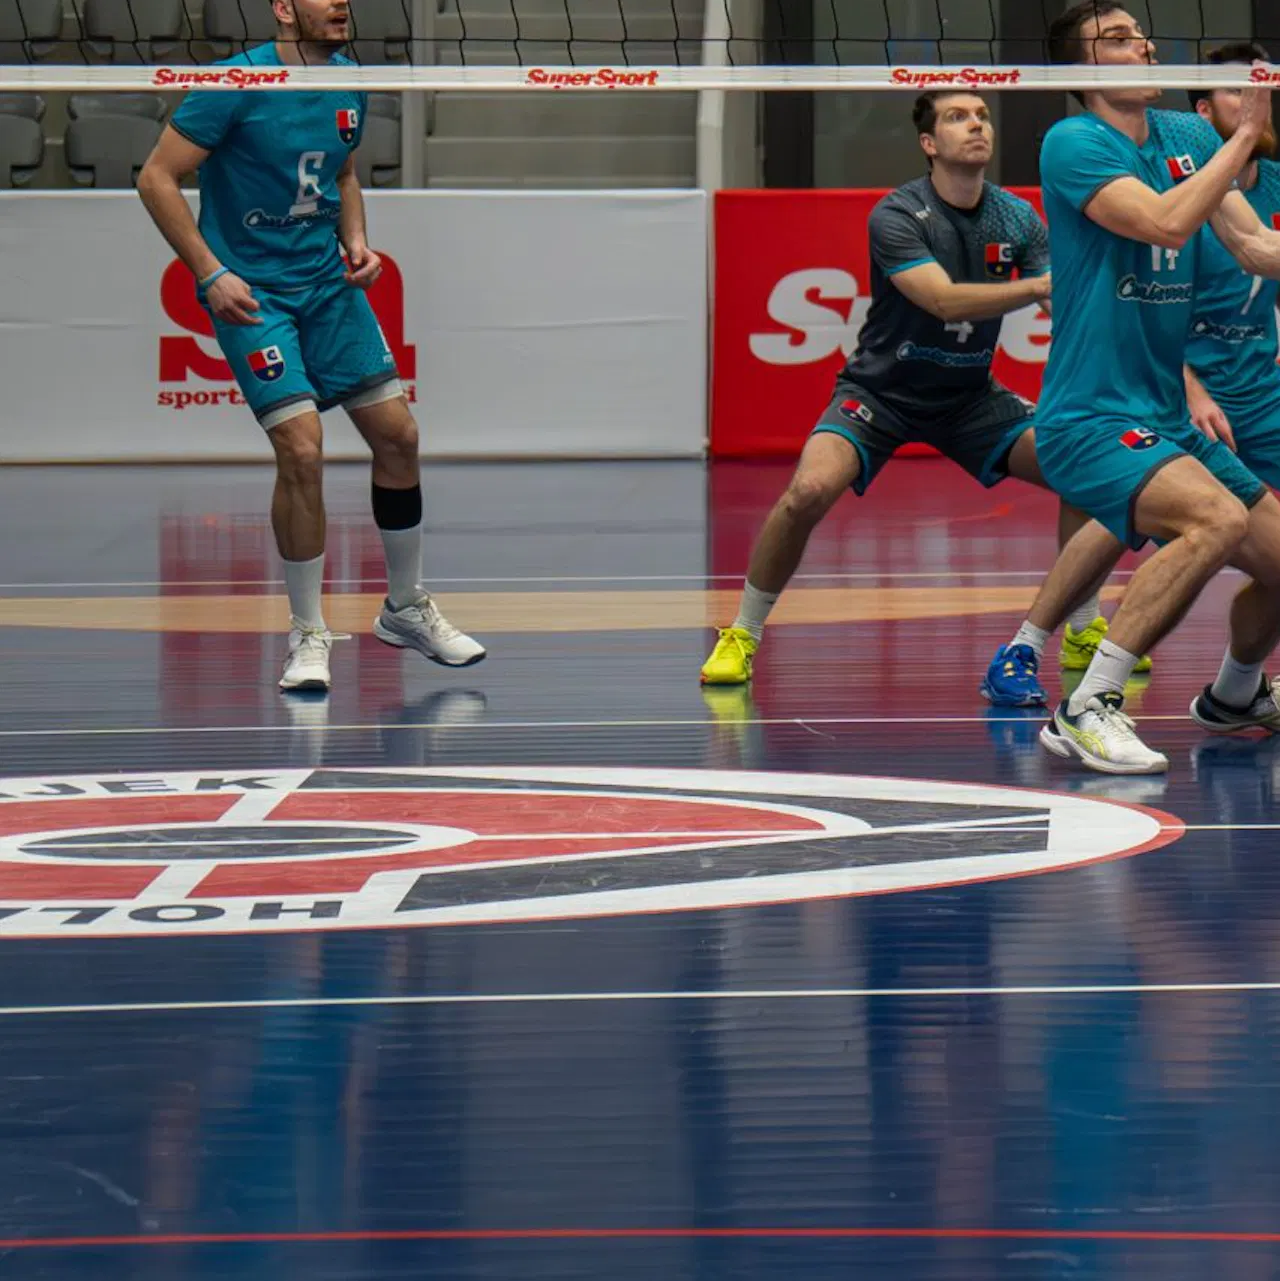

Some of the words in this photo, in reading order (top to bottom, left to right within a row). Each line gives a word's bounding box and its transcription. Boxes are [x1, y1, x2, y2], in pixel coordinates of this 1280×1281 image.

[154, 68, 290, 90] SuperSport
[527, 68, 659, 90] SuperSport
[890, 67, 1021, 89] SuperSport
[157, 388, 246, 410] sport
[0, 776, 277, 799] JEK
[0, 900, 344, 925] HOL
